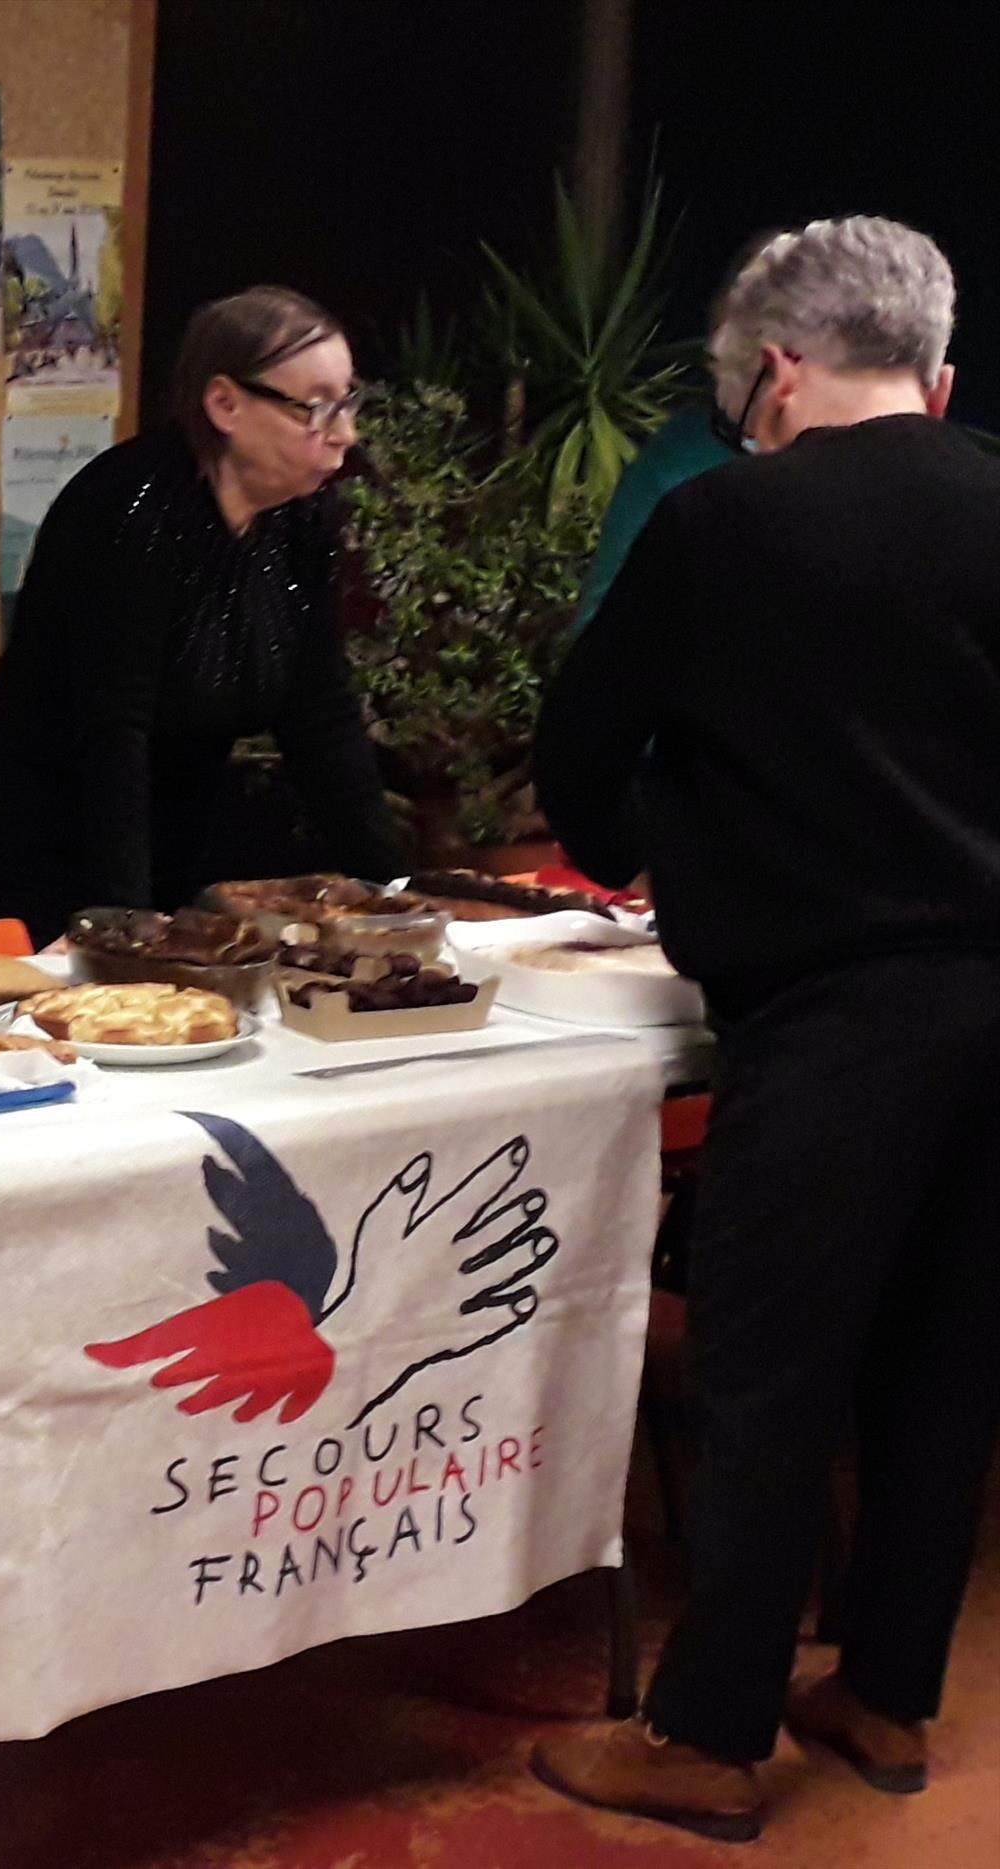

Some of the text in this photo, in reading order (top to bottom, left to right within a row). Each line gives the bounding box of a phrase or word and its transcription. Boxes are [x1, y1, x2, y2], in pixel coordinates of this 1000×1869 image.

[151, 1394, 484, 1515] SECOURS
[253, 1426, 545, 1537] POPULAIRE
[189, 1492, 477, 1606] FRANÇAIS
